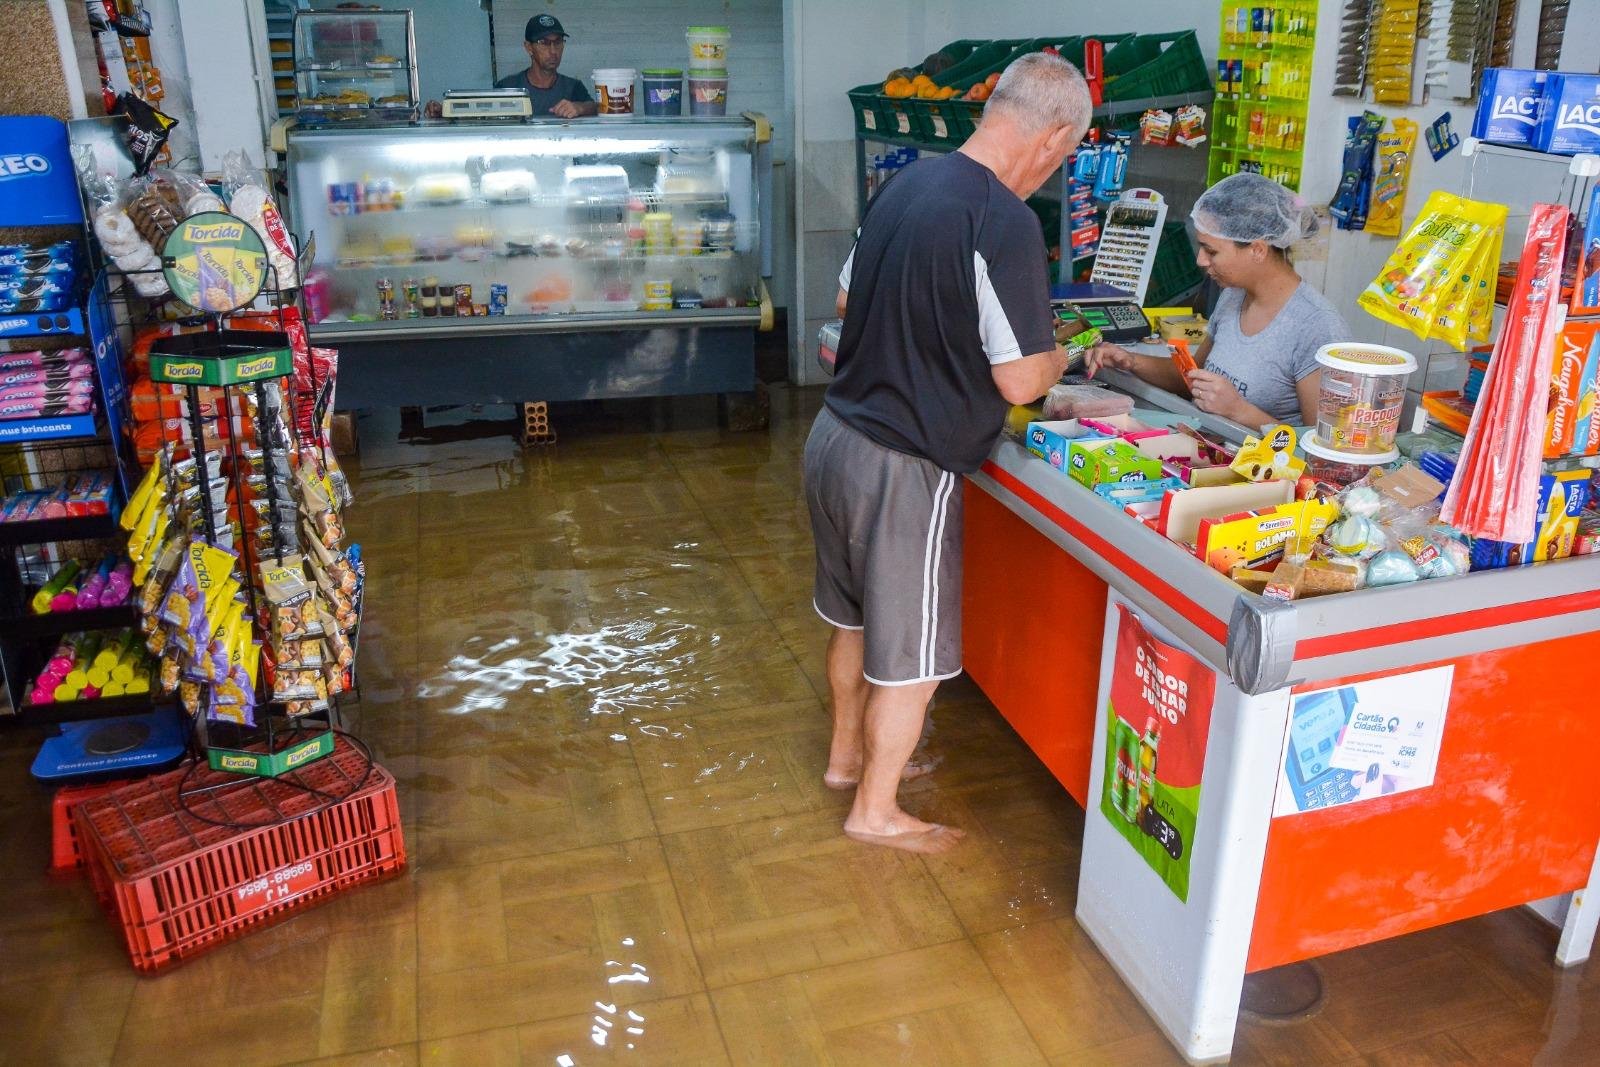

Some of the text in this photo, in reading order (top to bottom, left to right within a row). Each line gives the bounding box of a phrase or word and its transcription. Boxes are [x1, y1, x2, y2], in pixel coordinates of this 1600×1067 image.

[1491, 95, 1545, 118] LACT
[1557, 104, 1600, 129] LAC
[0, 155, 48, 176] REO
[190, 226, 241, 240] Torcida
[167, 364, 201, 376] Torcida
[240, 359, 274, 375] Torcida
[5, 372, 36, 383] OREO
[1552, 336, 1583, 446] Neugebauer
[0, 424, 72, 435] nue brincante
[1032, 432, 1045, 443] Fini
[1073, 455, 1085, 467] Fini
[1568, 484, 1580, 513] LACTA
[1255, 529, 1296, 552] BOLINHO
[190, 546, 210, 590] Torcida
[1137, 646, 1145, 662] O
[1146, 655, 1188, 699] SABOR
[1136, 661, 1187, 717] DE ESTAR
[1142, 684, 1178, 725] JUNTO
[1353, 722, 1387, 732] Cidadão
[1357, 712, 1384, 723] Cartão
[223, 757, 256, 769] Torcida
[290, 744, 320, 763] Torcida
